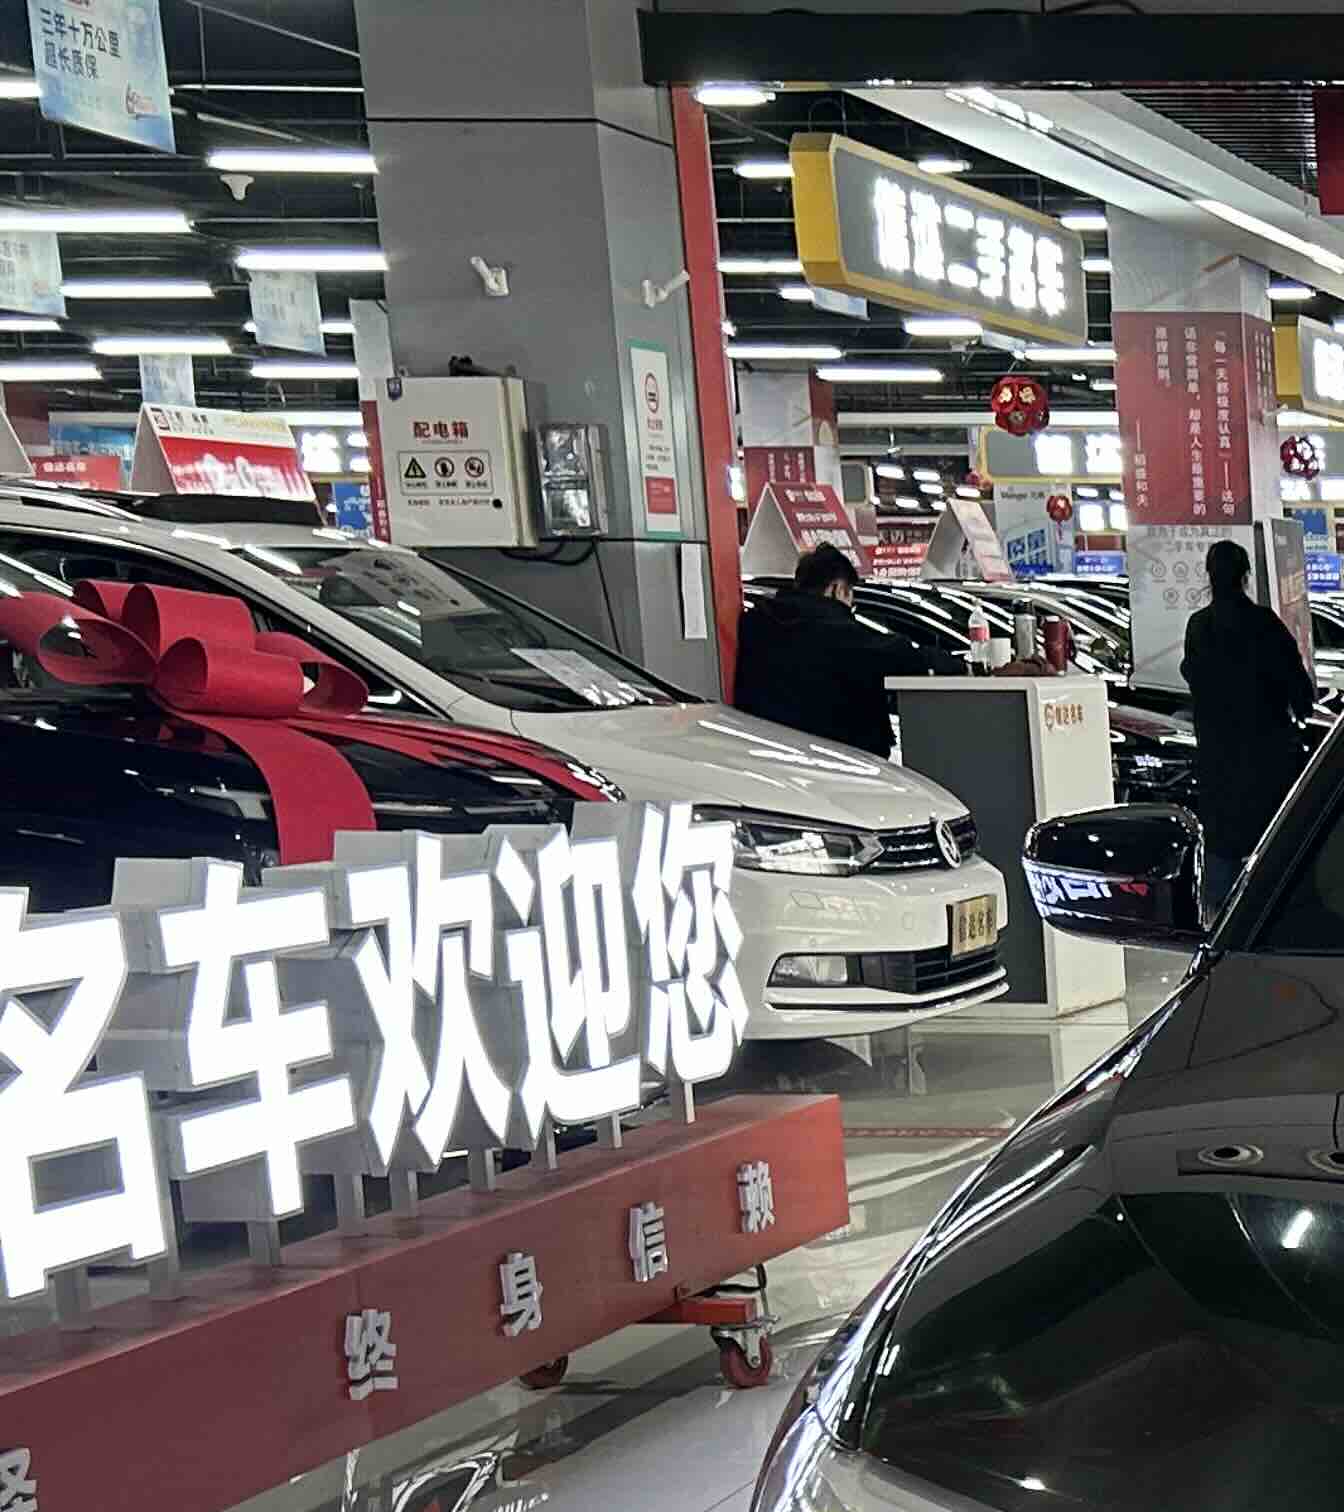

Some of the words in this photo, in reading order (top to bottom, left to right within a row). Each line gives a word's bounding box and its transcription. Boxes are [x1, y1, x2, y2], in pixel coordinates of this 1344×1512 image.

[413, 421, 469, 440] 配电箱
[0, 802, 750, 1298] 名车欢迎您
[344, 1160, 776, 1400] 终身信赖
